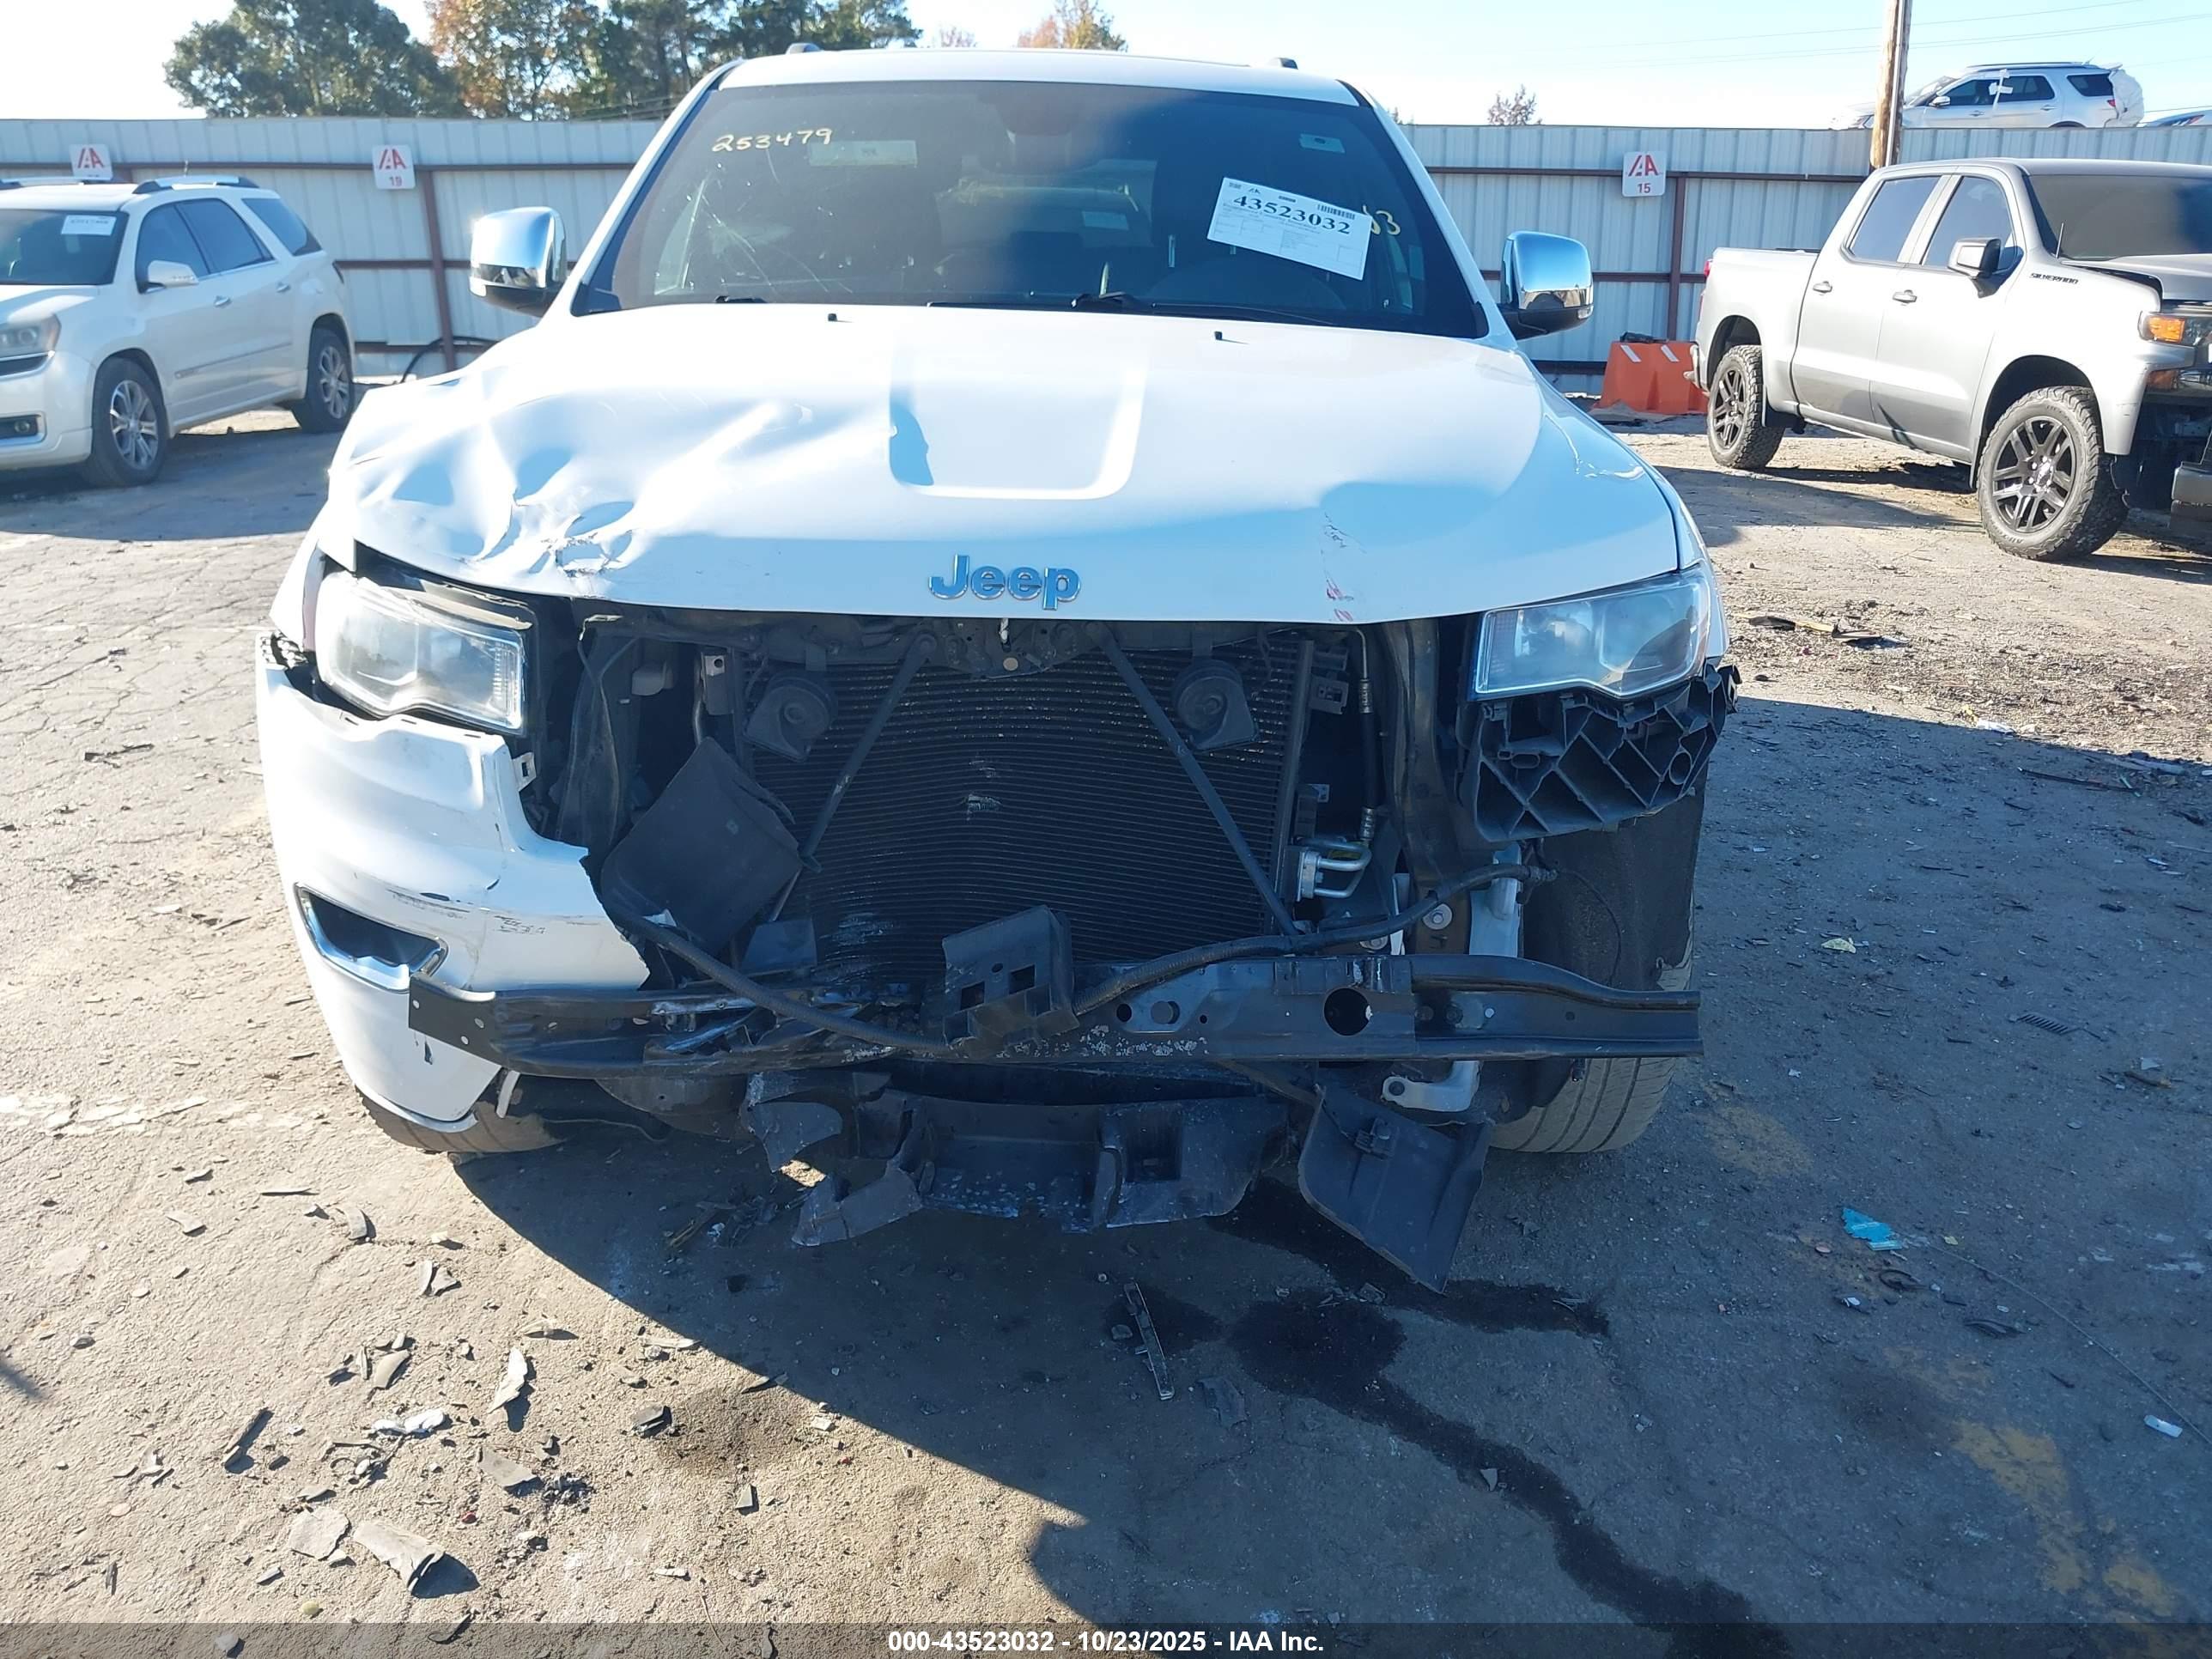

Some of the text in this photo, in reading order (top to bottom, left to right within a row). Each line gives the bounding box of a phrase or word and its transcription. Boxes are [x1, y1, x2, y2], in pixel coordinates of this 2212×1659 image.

[712, 127, 833, 153] 253479
[1638, 182, 1651, 194] 15
[1232, 195, 1351, 234] 43523032
[928, 554, 1081, 611] Jeep
